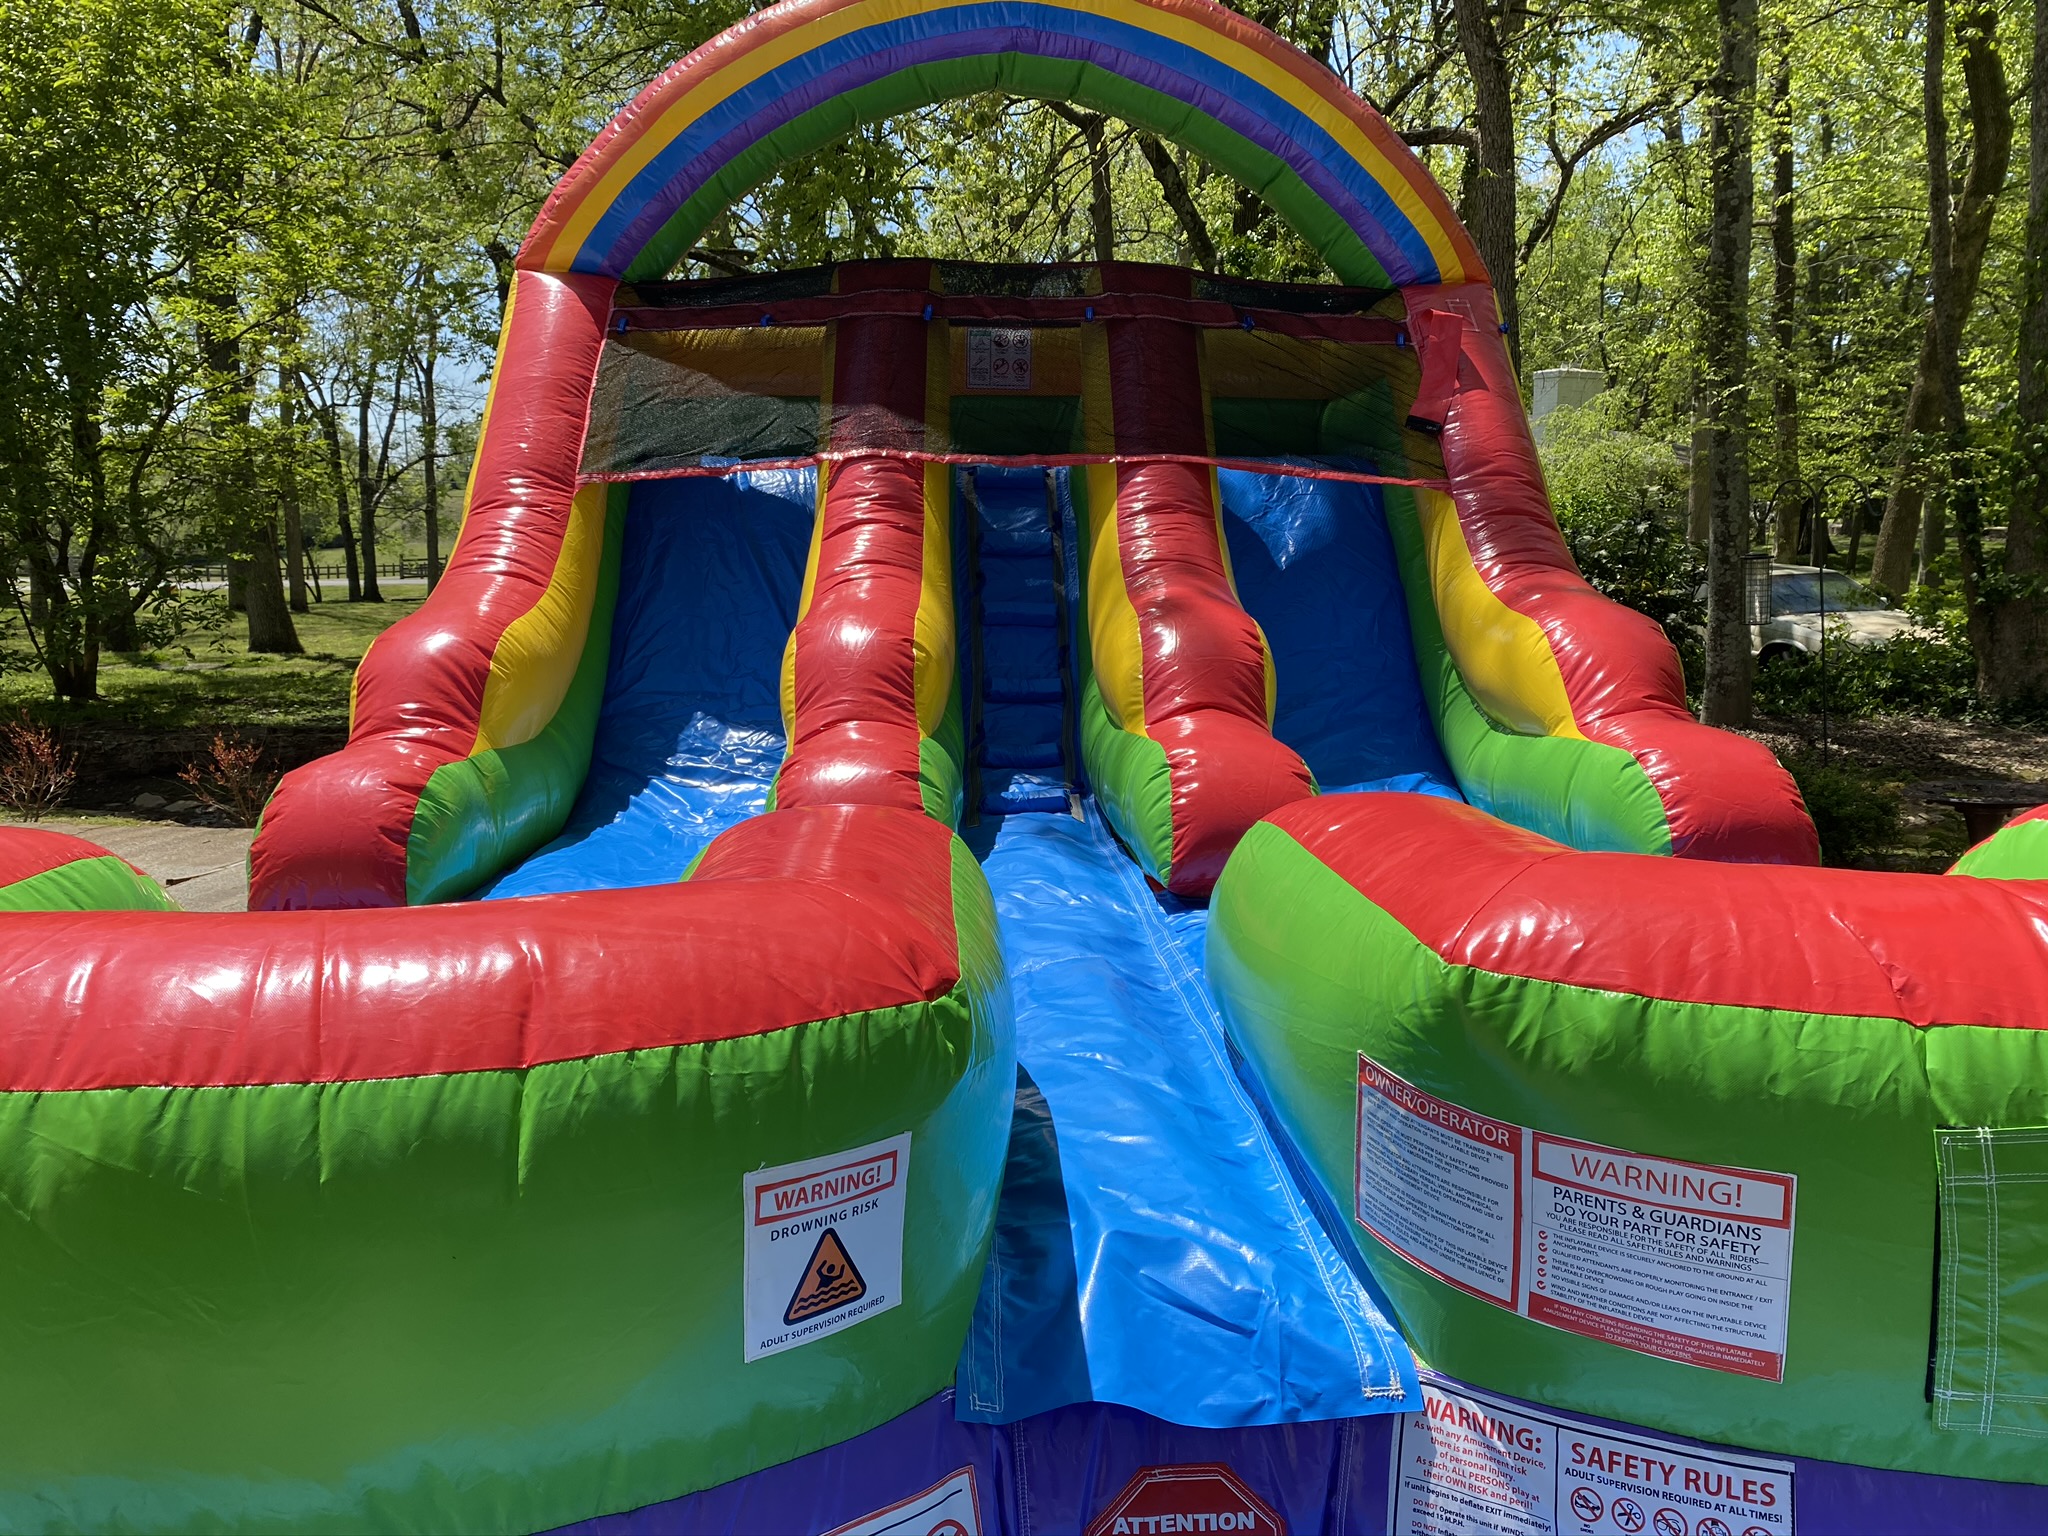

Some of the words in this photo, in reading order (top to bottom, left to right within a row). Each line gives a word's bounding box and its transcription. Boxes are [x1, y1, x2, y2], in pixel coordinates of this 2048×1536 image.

[1366, 1066, 1510, 1147] OWNER/OPERATOR
[774, 1165, 881, 1211] WARNING!
[1571, 1154, 1742, 1208] WARNING!
[771, 1209, 848, 1241] DROWNING
[852, 1198, 879, 1217] RISK
[1546, 1211, 1561, 1222] YOU
[1563, 1216, 1576, 1226] ARE
[1579, 1220, 1628, 1238] RESPONSIBLE
[1630, 1233, 1646, 1242] FOR
[1648, 1237, 1663, 1246] THE
[1665, 1241, 1695, 1253] SAFETY
[1697, 1247, 1707, 1255] OF
[1710, 1250, 1725, 1259] ALL
[1553, 1186, 1627, 1216] PARENTS
[1632, 1204, 1645, 1219] &
[1650, 1208, 1762, 1242] GUARDIANS
[1554, 1202, 1576, 1218] DO
[1579, 1208, 1619, 1228] YOUR
[1623, 1219, 1661, 1237] PART
[1665, 1228, 1696, 1244] FOR
[1700, 1235, 1761, 1256] SAFETY
[1553, 1240, 1576, 1251] ANCHOR
[1553, 1233, 1563, 1241] THE
[1565, 1237, 1597, 1250] INFLATABLE
[1598, 1245, 1619, 1255] DEVICE
[1626, 1253, 1655, 1264] SECURELY
[1657, 1260, 1691, 1272] ANCHORED
[1716, 1272, 1745, 1282] GROUND
[1560, 1223, 1586, 1235] PLEASE
[1588, 1231, 1608, 1241] READ
[1610, 1236, 1624, 1245] ALL
[1627, 1240, 1656, 1252] SAFETY
[1658, 1247, 1683, 1258] RULES
[1685, 1253, 1704, 1262] AND
[1706, 1257, 1752, 1271] WARNINGS
[1552, 1265, 1583, 1278] INFLATABLE
[1585, 1274, 1604, 1284] DEVICE
[1552, 1249, 1581, 1262] QUALIFIED
[1583, 1257, 1619, 1272] ATTENDANTS
[1621, 1267, 1631, 1275] ARE
[1634, 1271, 1663, 1283] PROPERLY
[1664, 1278, 1705, 1292] MONITORING
[1720, 1289, 1753, 1301] ENTRANCE
[1552, 1258, 1569, 1268] THERE
[1586, 1268, 1634, 1285] OVERCROWDING
[1645, 1283, 1667, 1293] ROUGH
[1669, 1289, 1684, 1297] PLAY
[1685, 1293, 1706, 1302] GOING
[1719, 1300, 1740, 1308] INSIDE
[760, 1334, 790, 1349] ADULT
[792, 1315, 846, 1339] SUPERVISION
[848, 1296, 885, 1318] REQUIRED
[1550, 1290, 1577, 1302] STABILITY
[1599, 1304, 1631, 1317] INFLATABLE
[1633, 1313, 1654, 1323] DEVICE
[1551, 1283, 1566, 1292] WIND
[1567, 1288, 1580, 1296] AND
[1581, 1292, 1608, 1304] WEATHER
[1609, 1300, 1646, 1314] CONDITIONS
[1660, 1313, 1673, 1321] NOT
[1711, 1324, 1724, 1332] THE
[1725, 1327, 1766, 1340] STRUCTURAL
[1552, 1273, 1560, 1281] NO
[1561, 1276, 1580, 1287] VISIBLE
[1582, 1283, 1598, 1292] SIGNS
[1609, 1290, 1634, 1302] DAMAGE
[1636, 1297, 1660, 1308] AND/OR
[1662, 1304, 1680, 1313] LEAKS
[1692, 1310, 1704, 1318] THE
[1706, 1313, 1742, 1325] INFLATABLE
[1744, 1321, 1767, 1330] DEVICE
[1414, 1420, 1424, 1430] As
[1427, 1424, 1444, 1436] with
[1446, 1430, 1461, 1443] any
[1463, 1434, 1511, 1459] Amusement
[1513, 1452, 1546, 1470] Device,
[1422, 1397, 1542, 1454] WARNING:
[1416, 1455, 1426, 1465] As
[1429, 1459, 1450, 1474] such,
[1452, 1467, 1466, 1478] ALL
[1469, 1472, 1510, 1491] PERSONS
[1512, 1486, 1529, 1501] play
[1532, 1493, 1540, 1503] at
[1431, 1436, 1452, 1450] there
[1453, 1443, 1460, 1452] is
[1462, 1447, 1473, 1456] an
[1475, 1450, 1510, 1469] inherent
[1511, 1464, 1527, 1475] risk
[1440, 1450, 1448, 1460] of
[1450, 1456, 1487, 1472] personal
[1489, 1466, 1515, 1483] injury.
[1571, 1443, 1676, 1486] SAFETY
[1684, 1468, 1776, 1507] RULES
[1405, 1481, 1410, 1489] If
[1411, 1482, 1425, 1493] unit
[1427, 1487, 1449, 1501] begins
[1451, 1495, 1458, 1503] to
[1460, 1497, 1484, 1511] deflate
[1485, 1506, 1502, 1517] EXIT
[1503, 1511, 1552, 1533] immediately!
[1424, 1469, 1444, 1482] their
[1446, 1475, 1466, 1489] OWN
[1468, 1483, 1488, 1496] RISK
[1490, 1489, 1507, 1501] and
[1510, 1496, 1533, 1510] peril!
[1565, 1467, 1595, 1482] ADULT
[1597, 1475, 1659, 1498] SUPERVISION
[1662, 1492, 1712, 1509] REQUIRED
[1714, 1503, 1727, 1513] AT
[1729, 1506, 1747, 1518] ALL
[1749, 1509, 1783, 1524] TIMES!
[1112, 1511, 1255, 1535] ATTENTION
[1412, 1520, 1422, 1529] DO
[1424, 1524, 1436, 1534] NOT
[1413, 1497, 1423, 1507] DO
[1424, 1501, 1438, 1511] NOT
[1439, 1506, 1465, 1521] Operate
[1466, 1515, 1478, 1524] this
[1479, 1519, 1492, 1529] unit
[1493, 1523, 1499, 1531] if
[1501, 1525, 1524, 1536] WINDS
[1413, 1505, 1434, 1519] exceed
[1436, 1513, 1443, 1521] 15
[1445, 1515, 1465, 1528] M.P.H.
